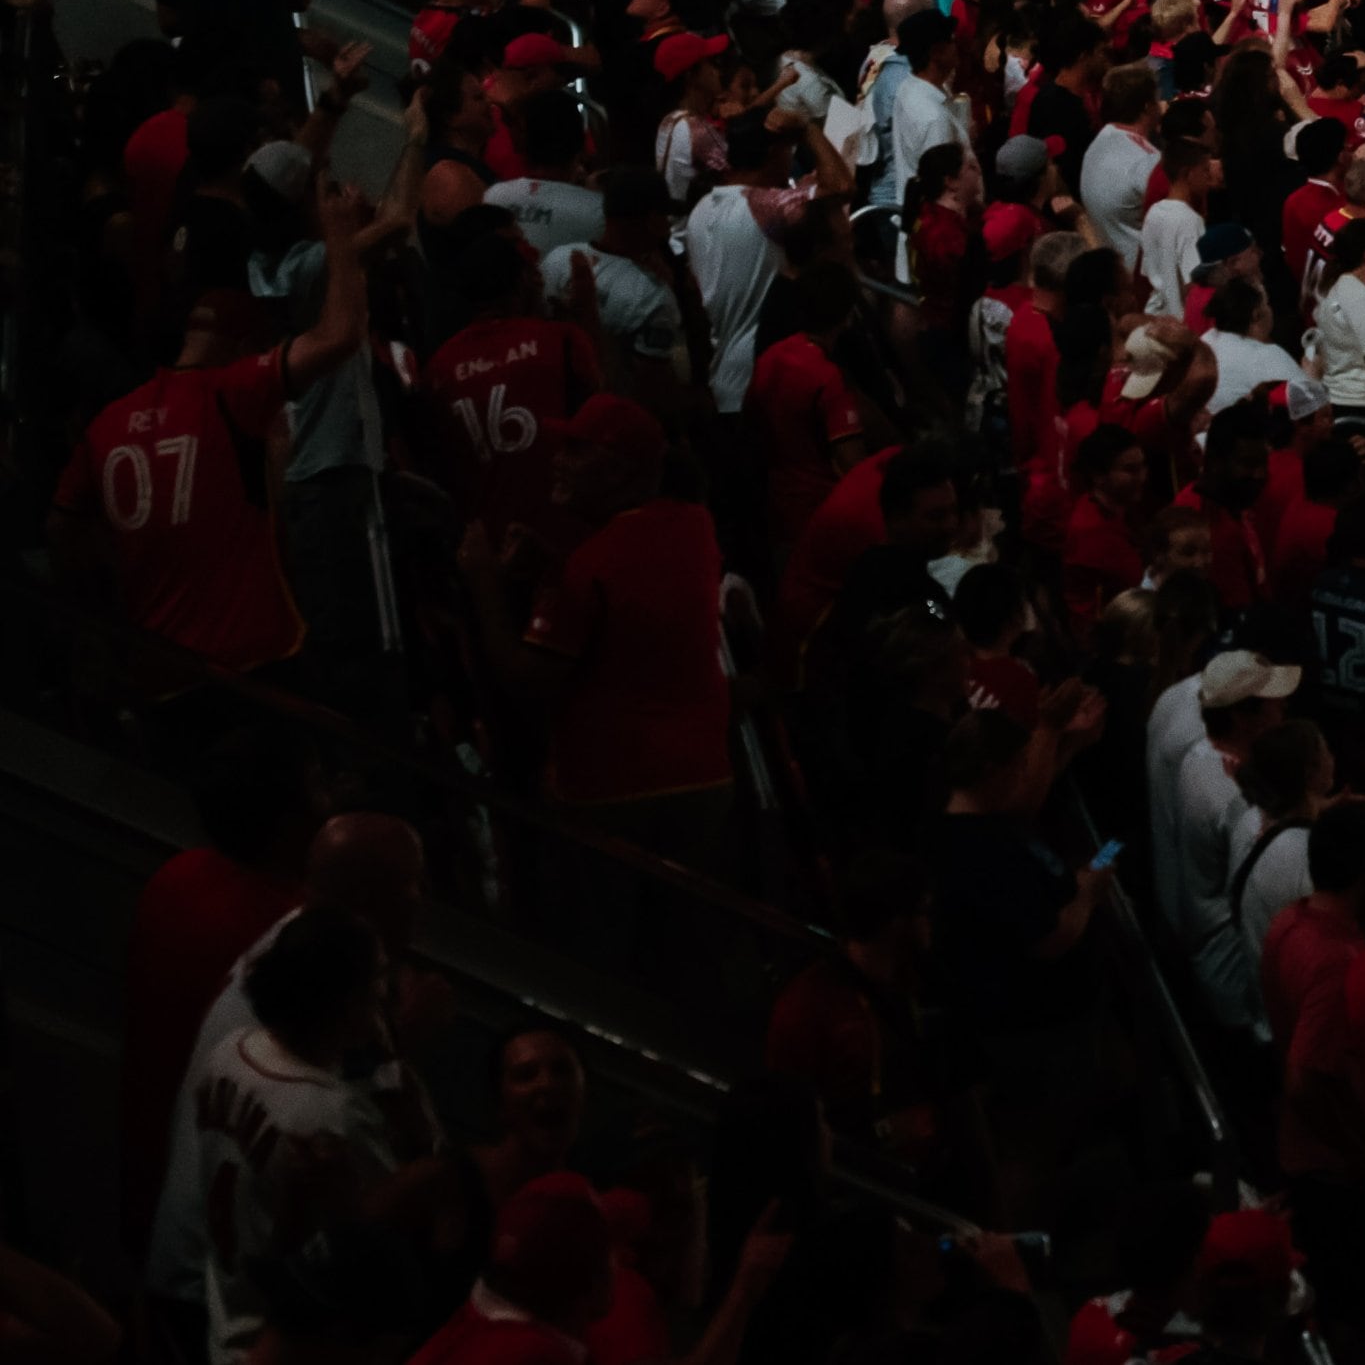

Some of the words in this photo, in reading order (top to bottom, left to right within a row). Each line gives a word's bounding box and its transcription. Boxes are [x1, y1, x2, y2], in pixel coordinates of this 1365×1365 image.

[128, 407, 169, 435] REY
[451, 382, 539, 466] 16
[102, 434, 200, 532] 07
